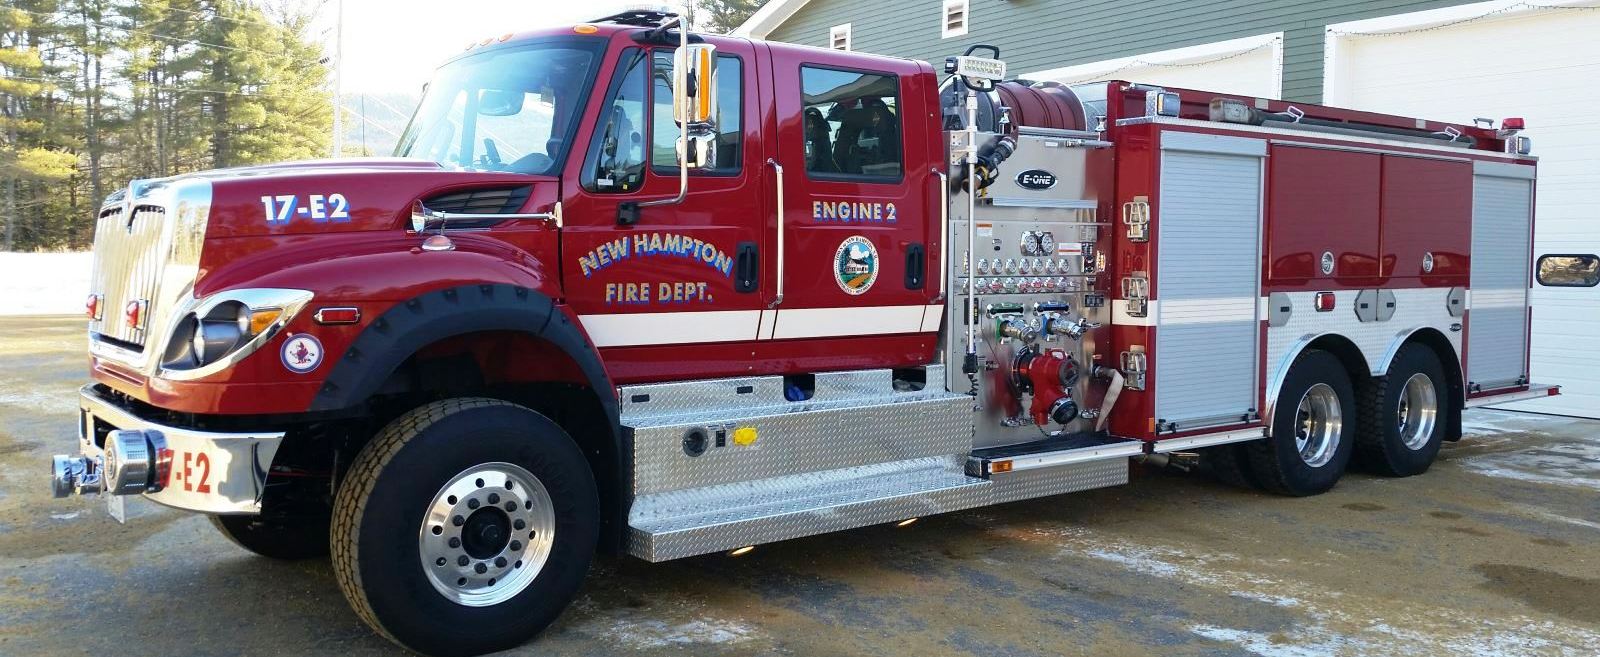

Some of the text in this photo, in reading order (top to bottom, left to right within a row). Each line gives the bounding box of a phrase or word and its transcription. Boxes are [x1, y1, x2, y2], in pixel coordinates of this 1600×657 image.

[1022, 174, 1052, 185] E-ONE
[261, 193, 350, 223] 17-E2
[813, 200, 897, 222] ENGINE 2
[578, 232, 733, 278] NEW HAMPTON
[605, 281, 713, 303] FIRE DEPT.
[158, 448, 210, 493] 7-E2
